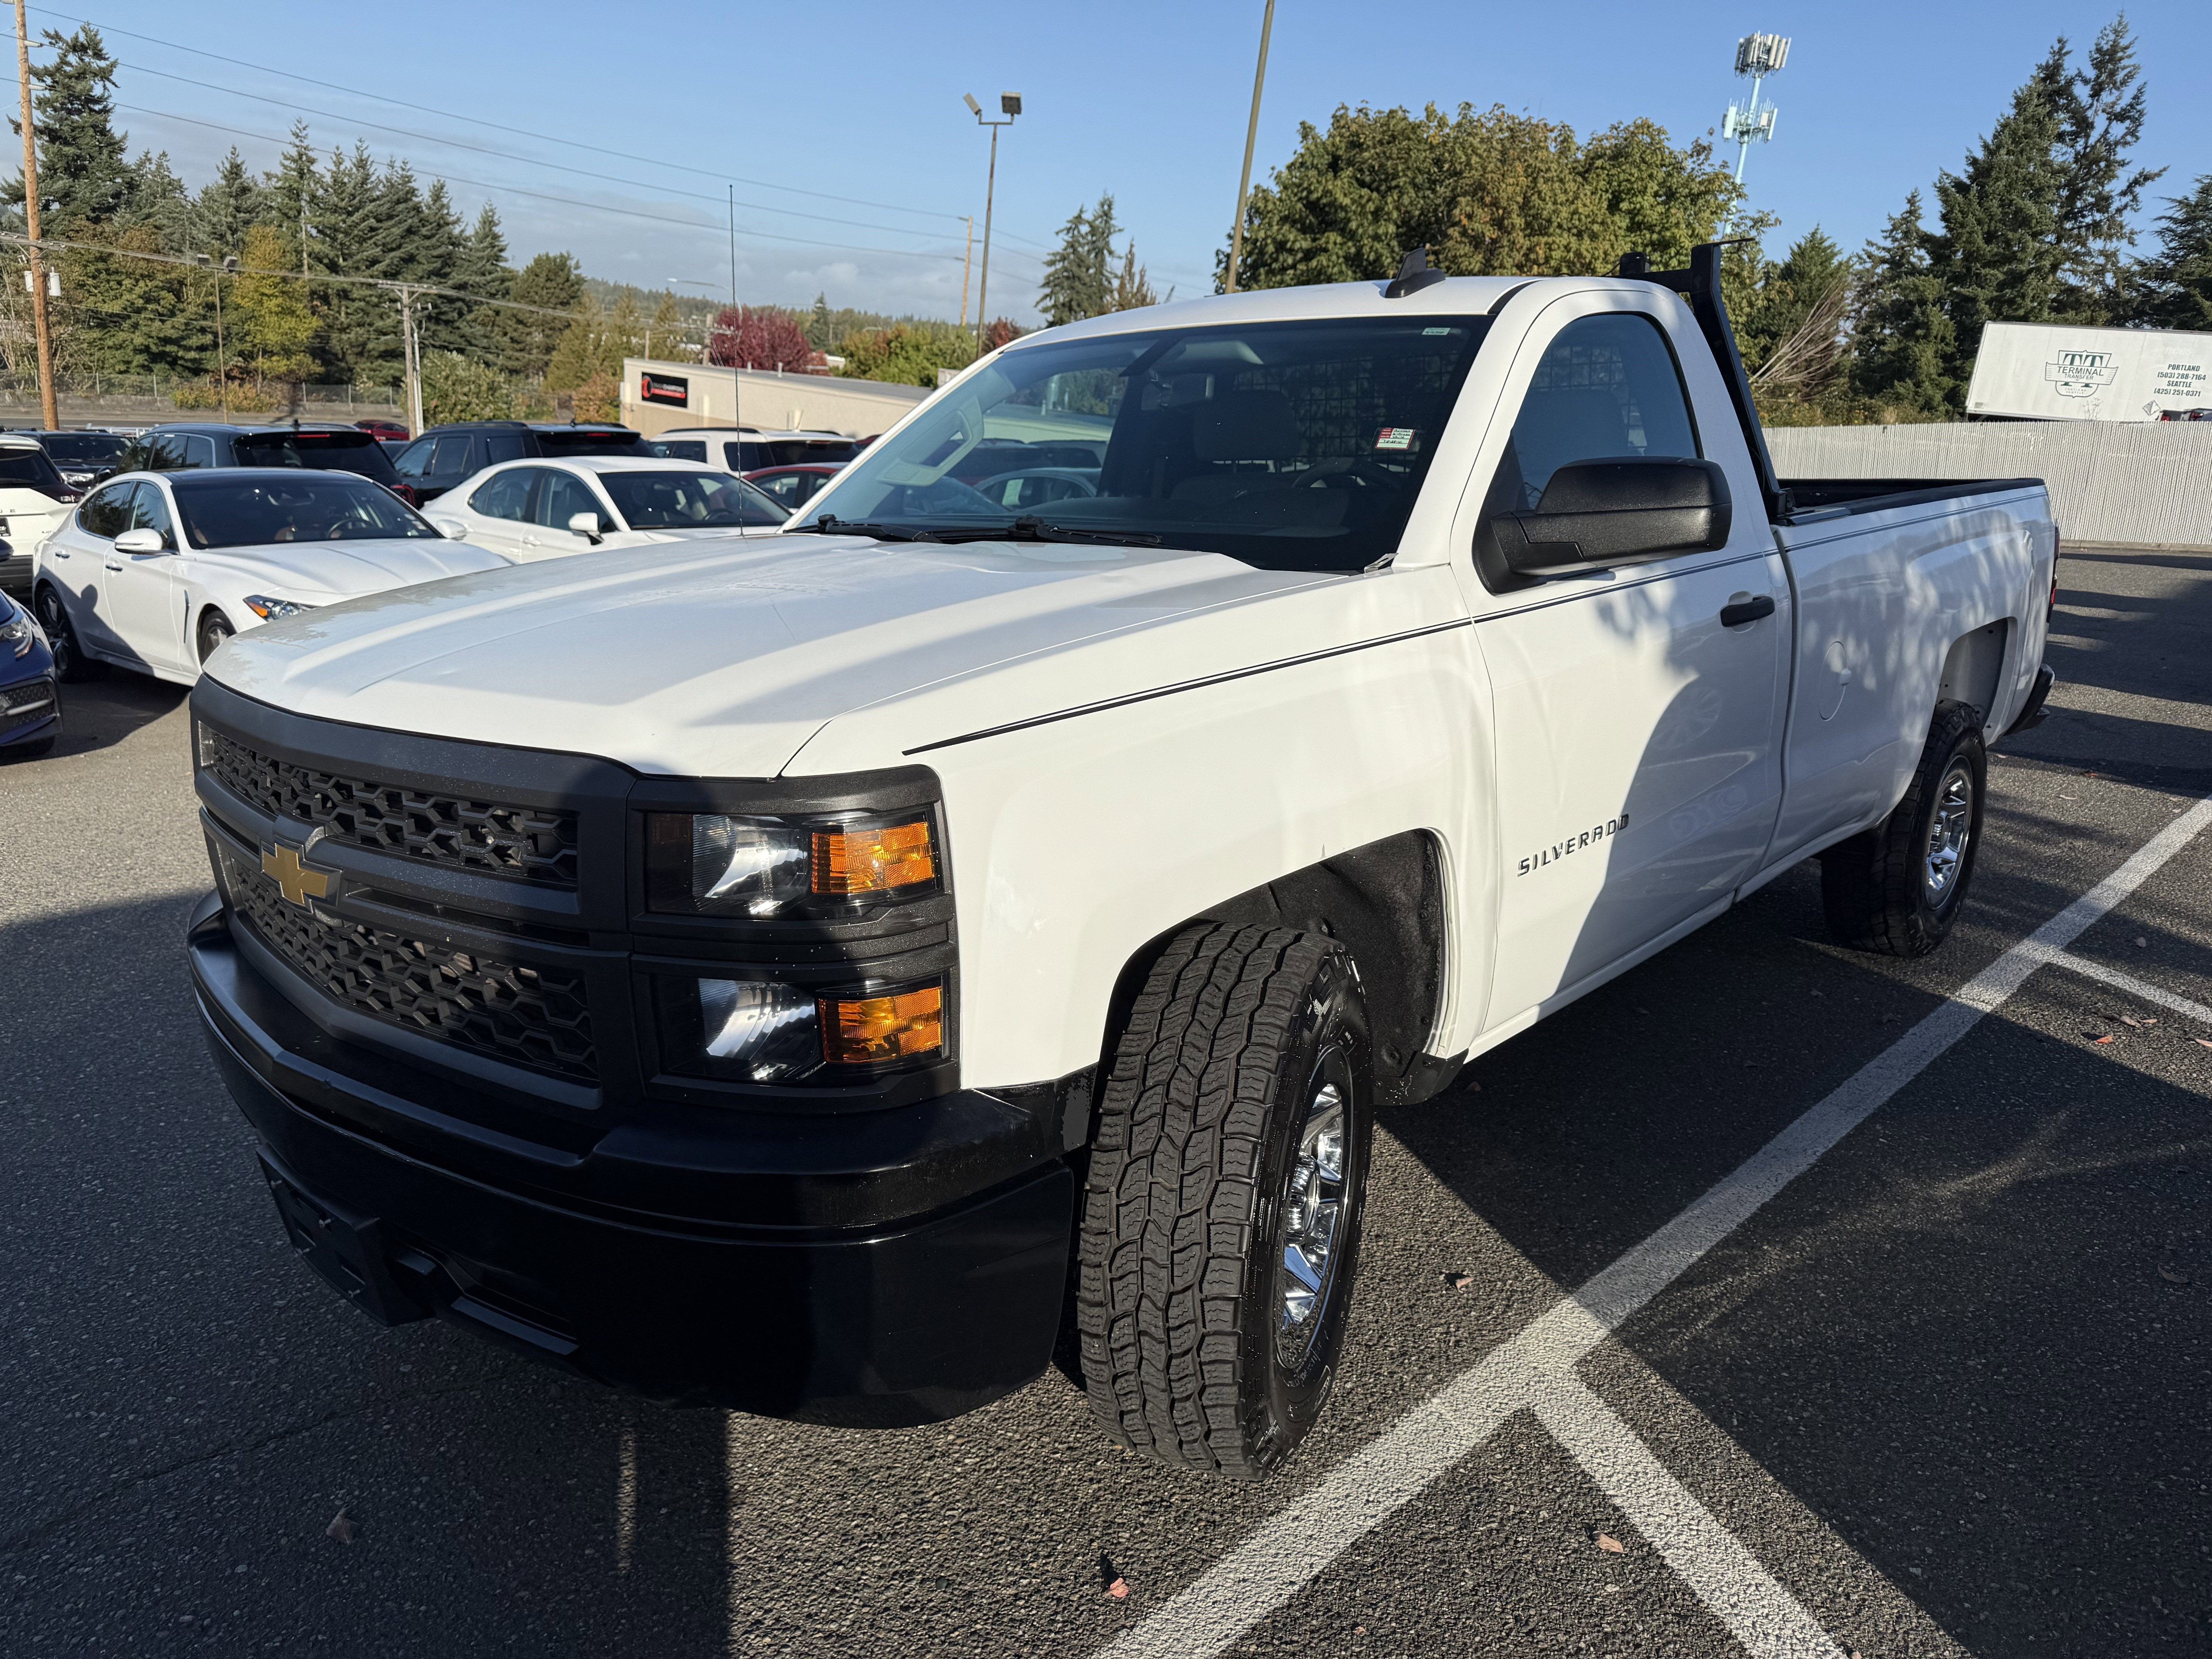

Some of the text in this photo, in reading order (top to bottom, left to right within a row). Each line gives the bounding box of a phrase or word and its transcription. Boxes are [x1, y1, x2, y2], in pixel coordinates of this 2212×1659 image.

[2057, 366, 2104, 376] TERMINAL
[2172, 389, 2201, 397] 251-0371
[1517, 814, 1629, 877] SILVERADO
